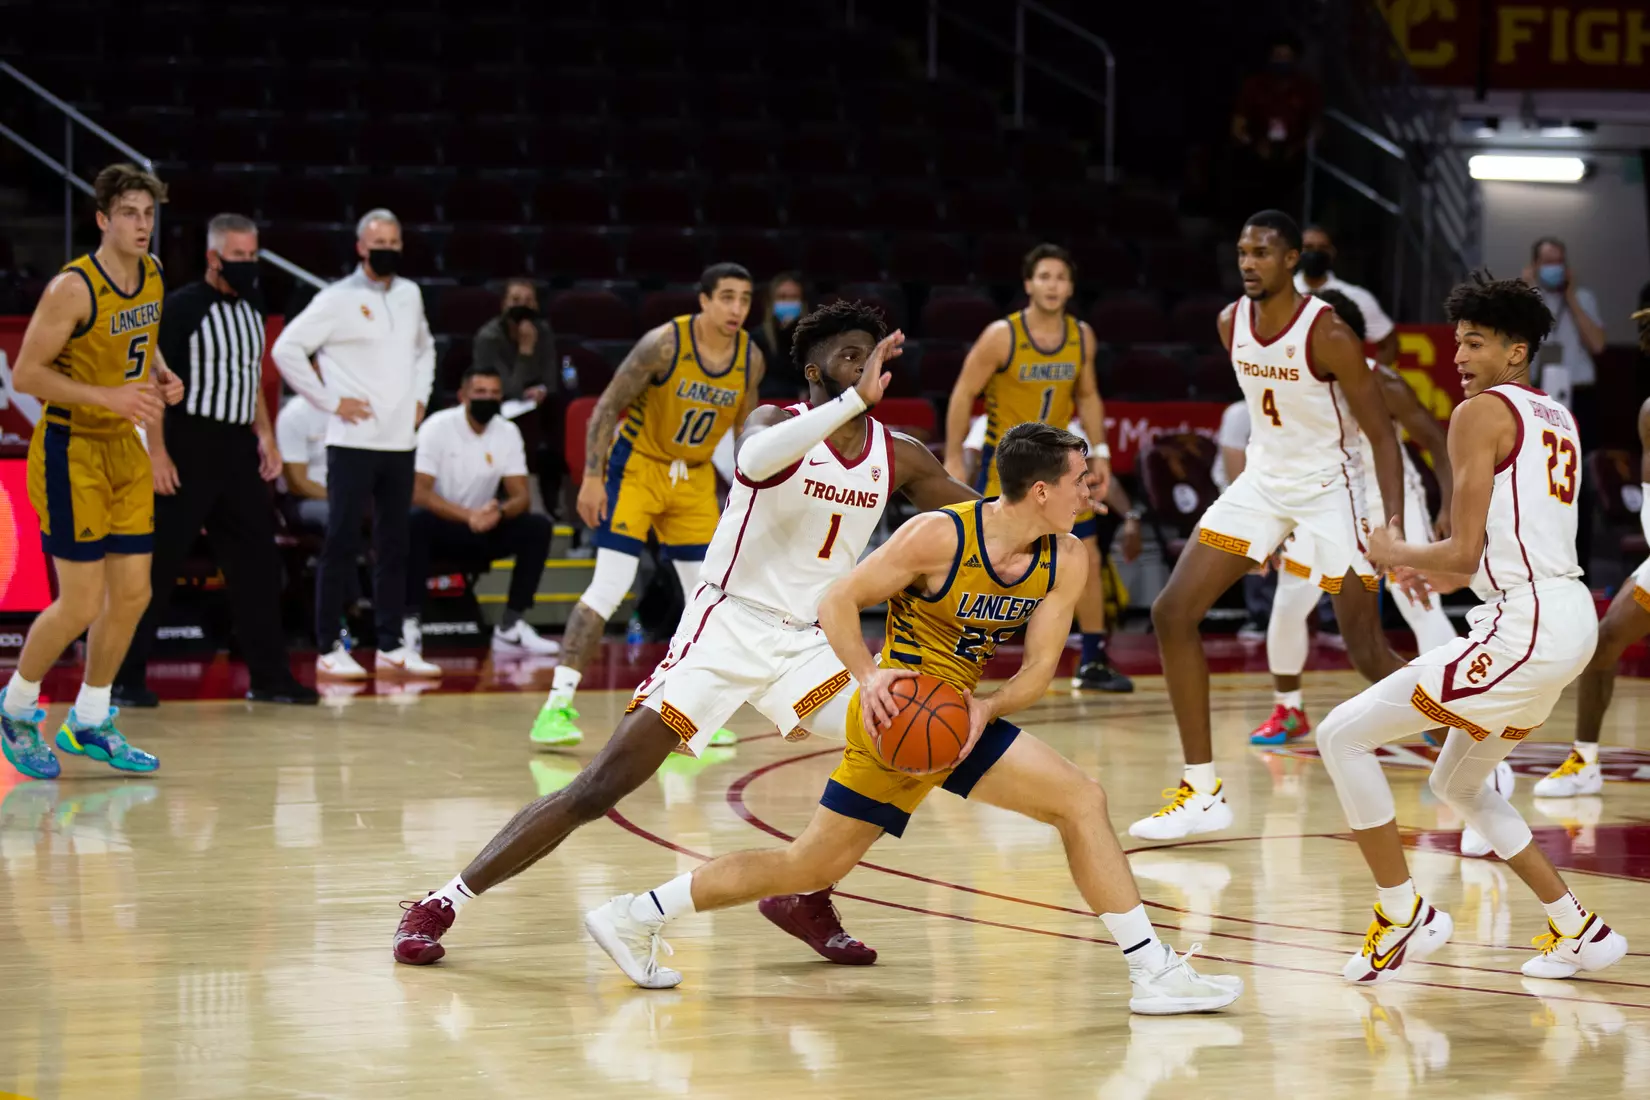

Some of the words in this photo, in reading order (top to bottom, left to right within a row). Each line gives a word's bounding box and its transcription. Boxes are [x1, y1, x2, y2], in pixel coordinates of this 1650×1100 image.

[110, 301, 161, 336] LANCERS
[124, 332, 150, 381] 5
[1018, 362, 1077, 383] LANCERS
[1236, 360, 1300, 382] TROJANS
[676, 378, 739, 408] LANCERS
[1038, 385, 1057, 424] 1
[1262, 388, 1282, 427] 4
[673, 407, 718, 447] 10
[1542, 429, 1578, 506] 23
[803, 478, 879, 509] TROJANS
[817, 512, 843, 560] 1
[1465, 652, 1493, 685] SC
